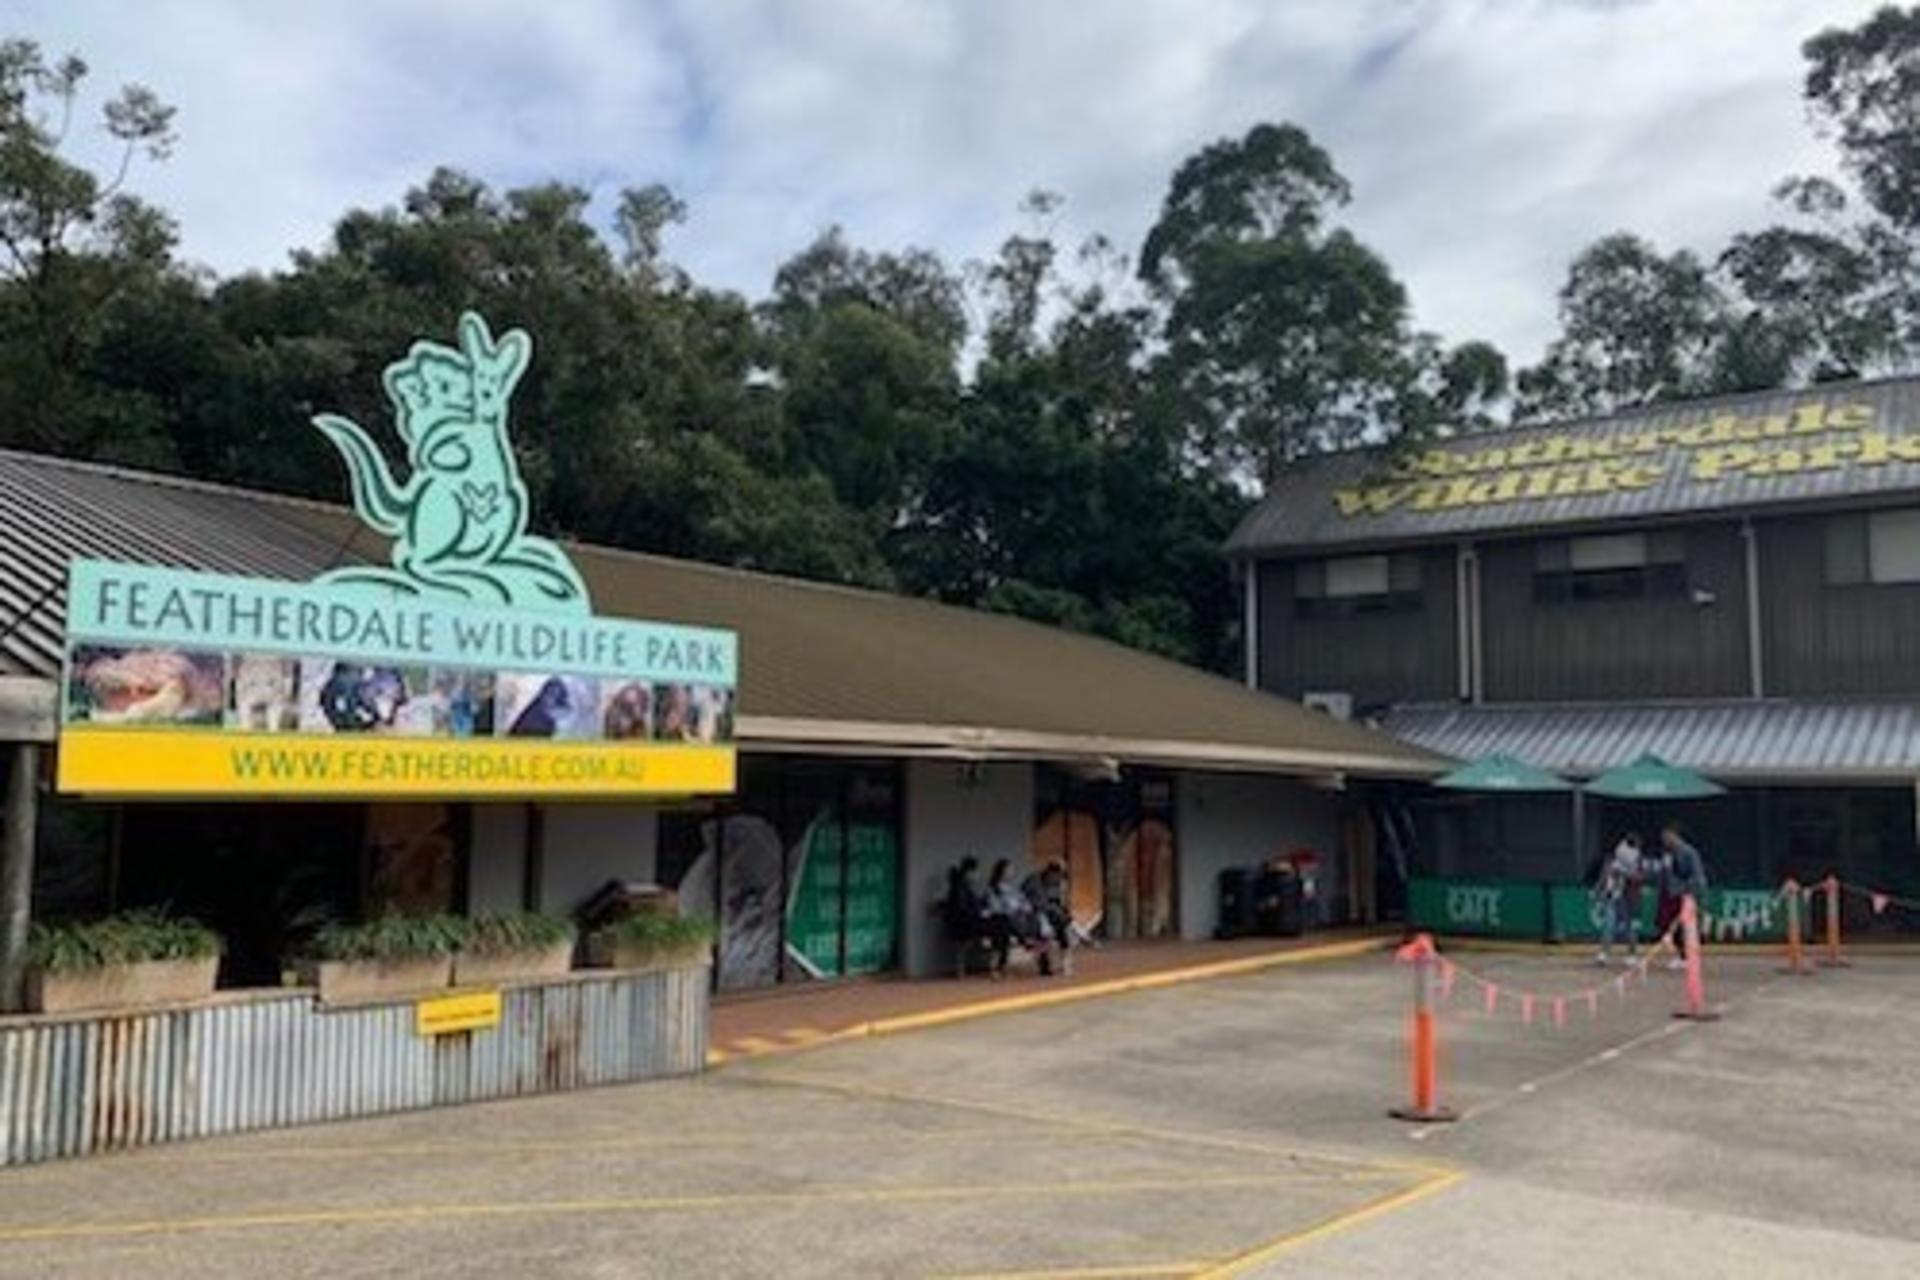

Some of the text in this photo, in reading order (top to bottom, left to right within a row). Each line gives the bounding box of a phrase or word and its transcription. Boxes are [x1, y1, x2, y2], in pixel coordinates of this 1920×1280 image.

[1390, 403, 1874, 475] eatherdale
[98, 579, 723, 675] FEATHERDALE WILDLIFE PARK
[231, 748, 646, 783] WWW.FEATHERDALE.COM.AU
